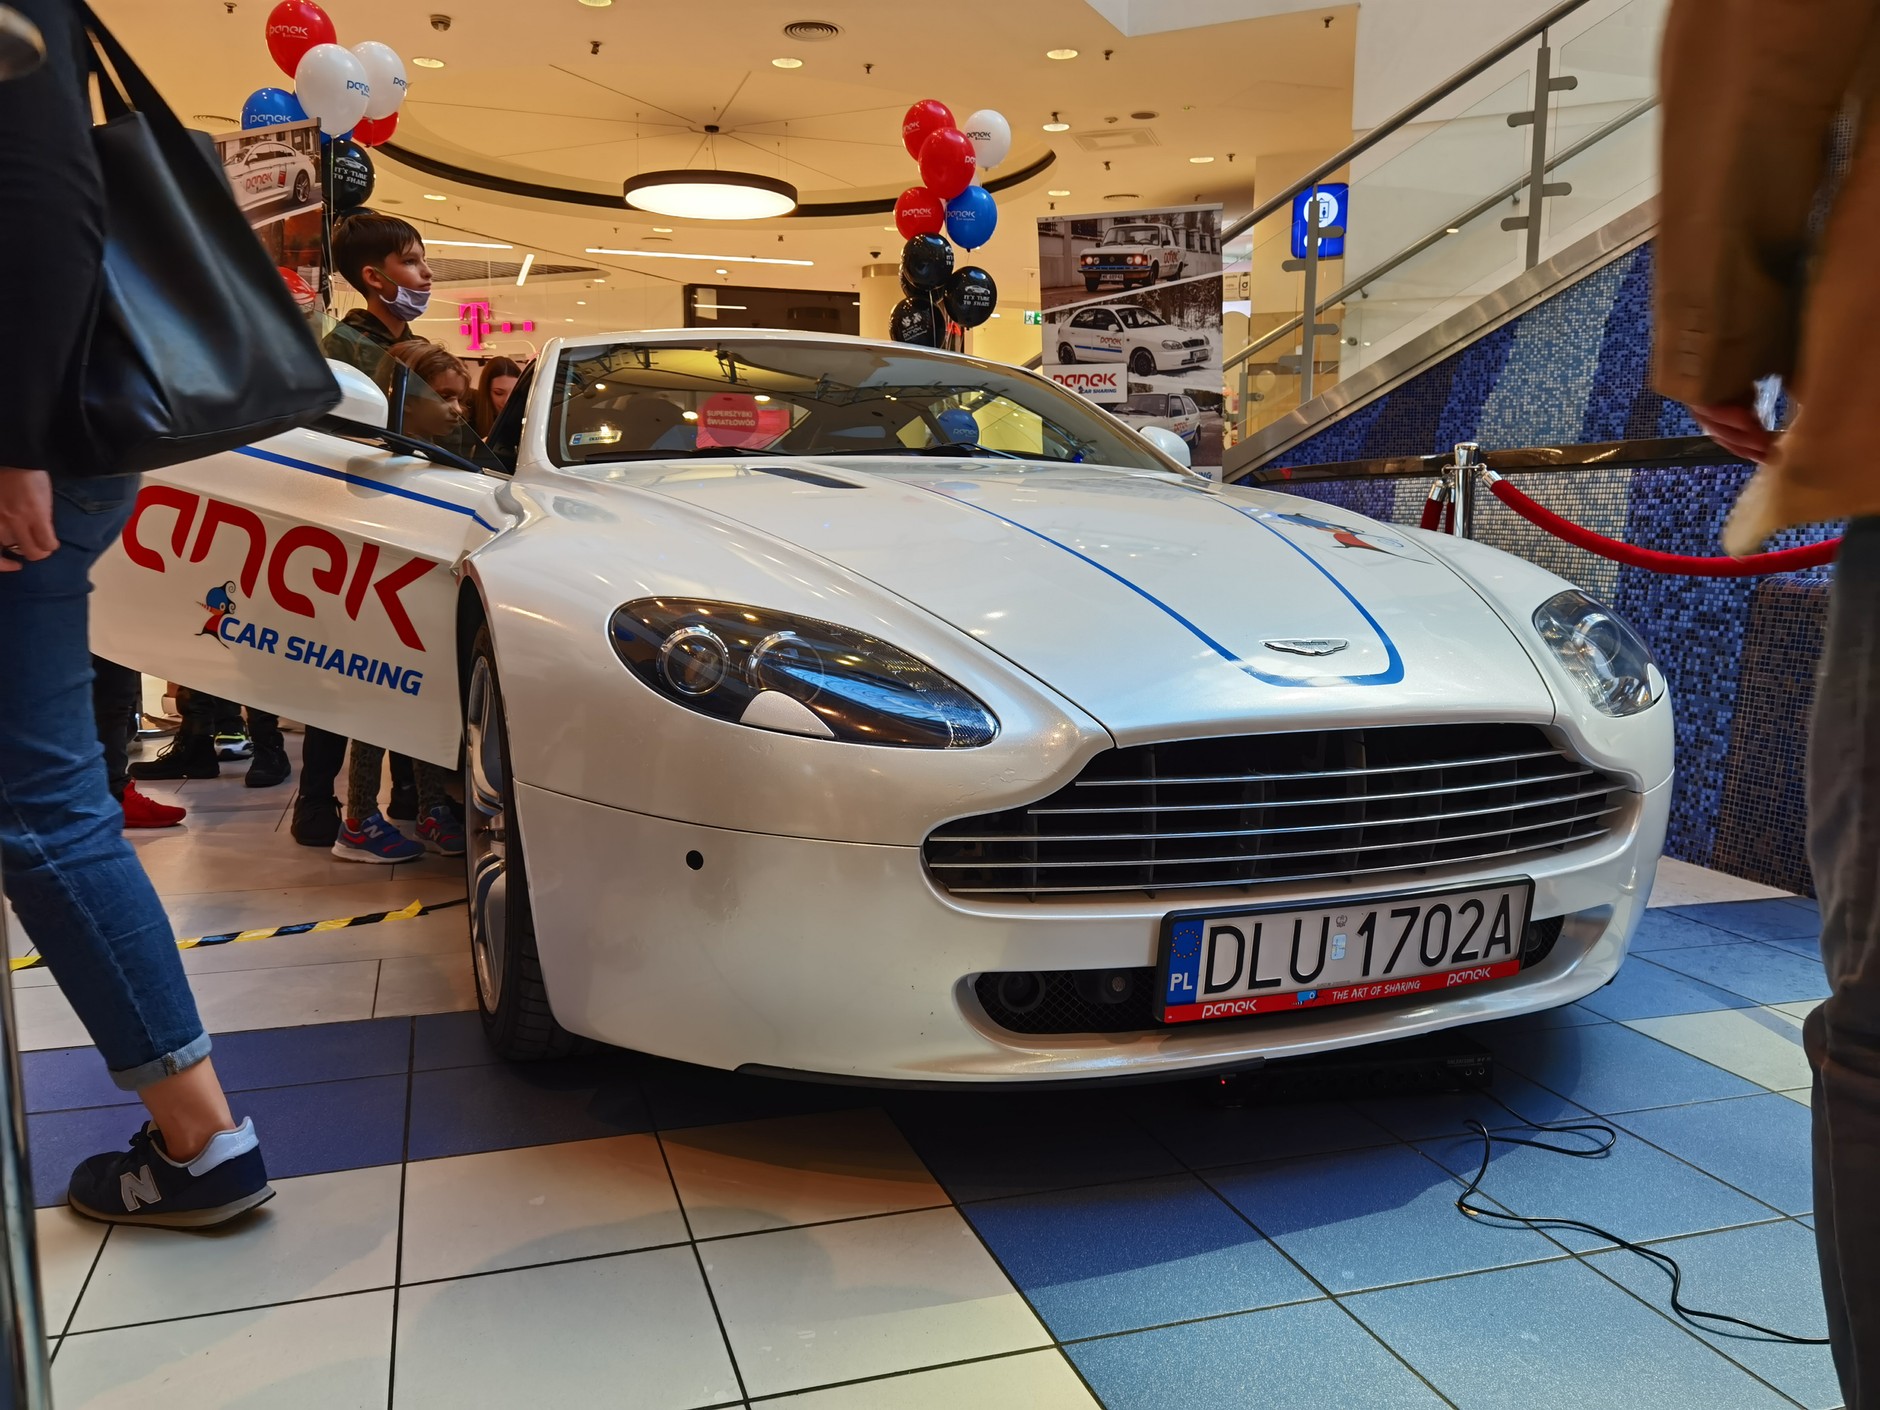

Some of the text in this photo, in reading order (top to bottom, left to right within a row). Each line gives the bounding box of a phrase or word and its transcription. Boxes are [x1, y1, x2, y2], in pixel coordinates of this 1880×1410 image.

[269, 25, 308, 37] panek
[347, 80, 370, 93] pane
[250, 114, 292, 123] panek
[245, 172, 273, 189] panek
[902, 208, 932, 217] panek
[1053, 373, 1118, 388] panek
[706, 410, 754, 418] SUPERSZYBKI
[121, 485, 440, 653] anek
[220, 616, 424, 697] CAR SHARING
[1170, 972, 1193, 992] PL
[1202, 966, 1492, 1018] panek THE ART OF SHARING panek
[120, 1164, 162, 1212] N
